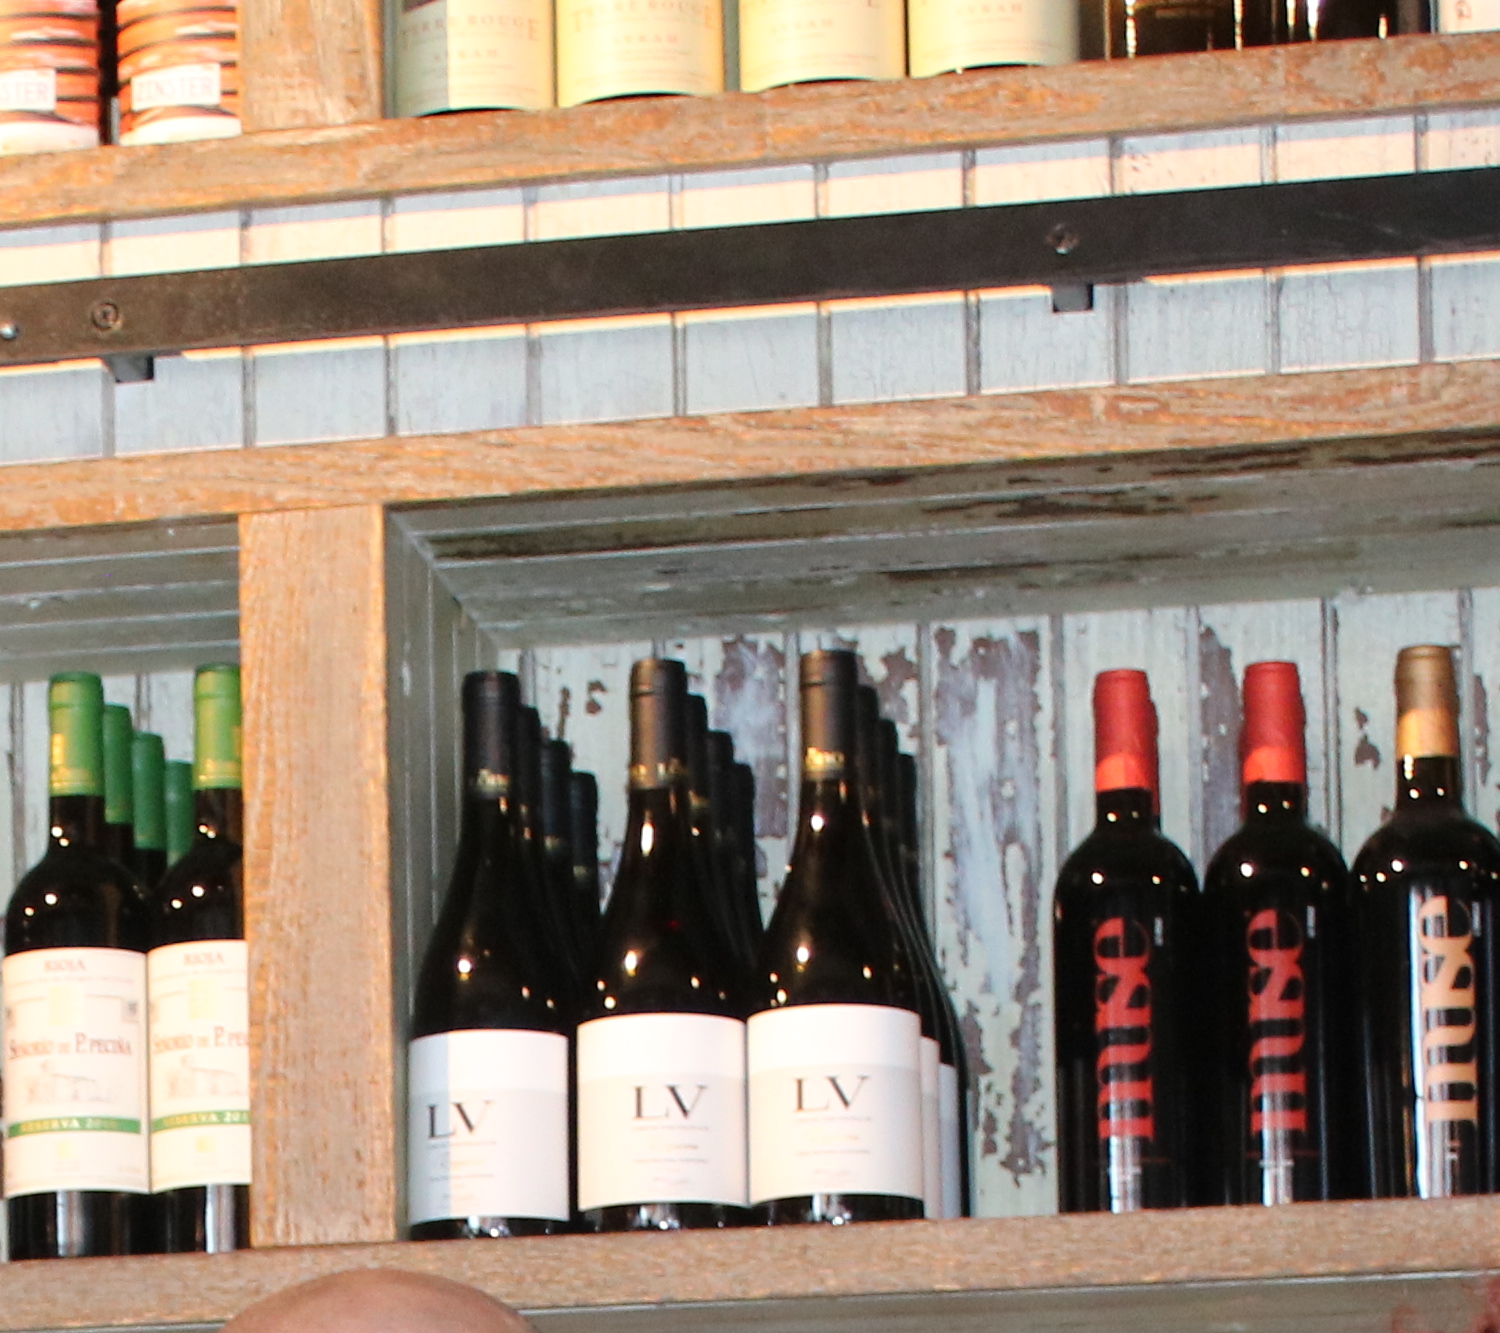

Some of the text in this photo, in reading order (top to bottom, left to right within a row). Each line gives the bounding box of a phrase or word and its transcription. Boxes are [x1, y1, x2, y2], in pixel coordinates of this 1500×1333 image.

[632, 1084, 708, 1121] LV
[793, 1074, 871, 1114] LV
[427, 1098, 496, 1140] LV
